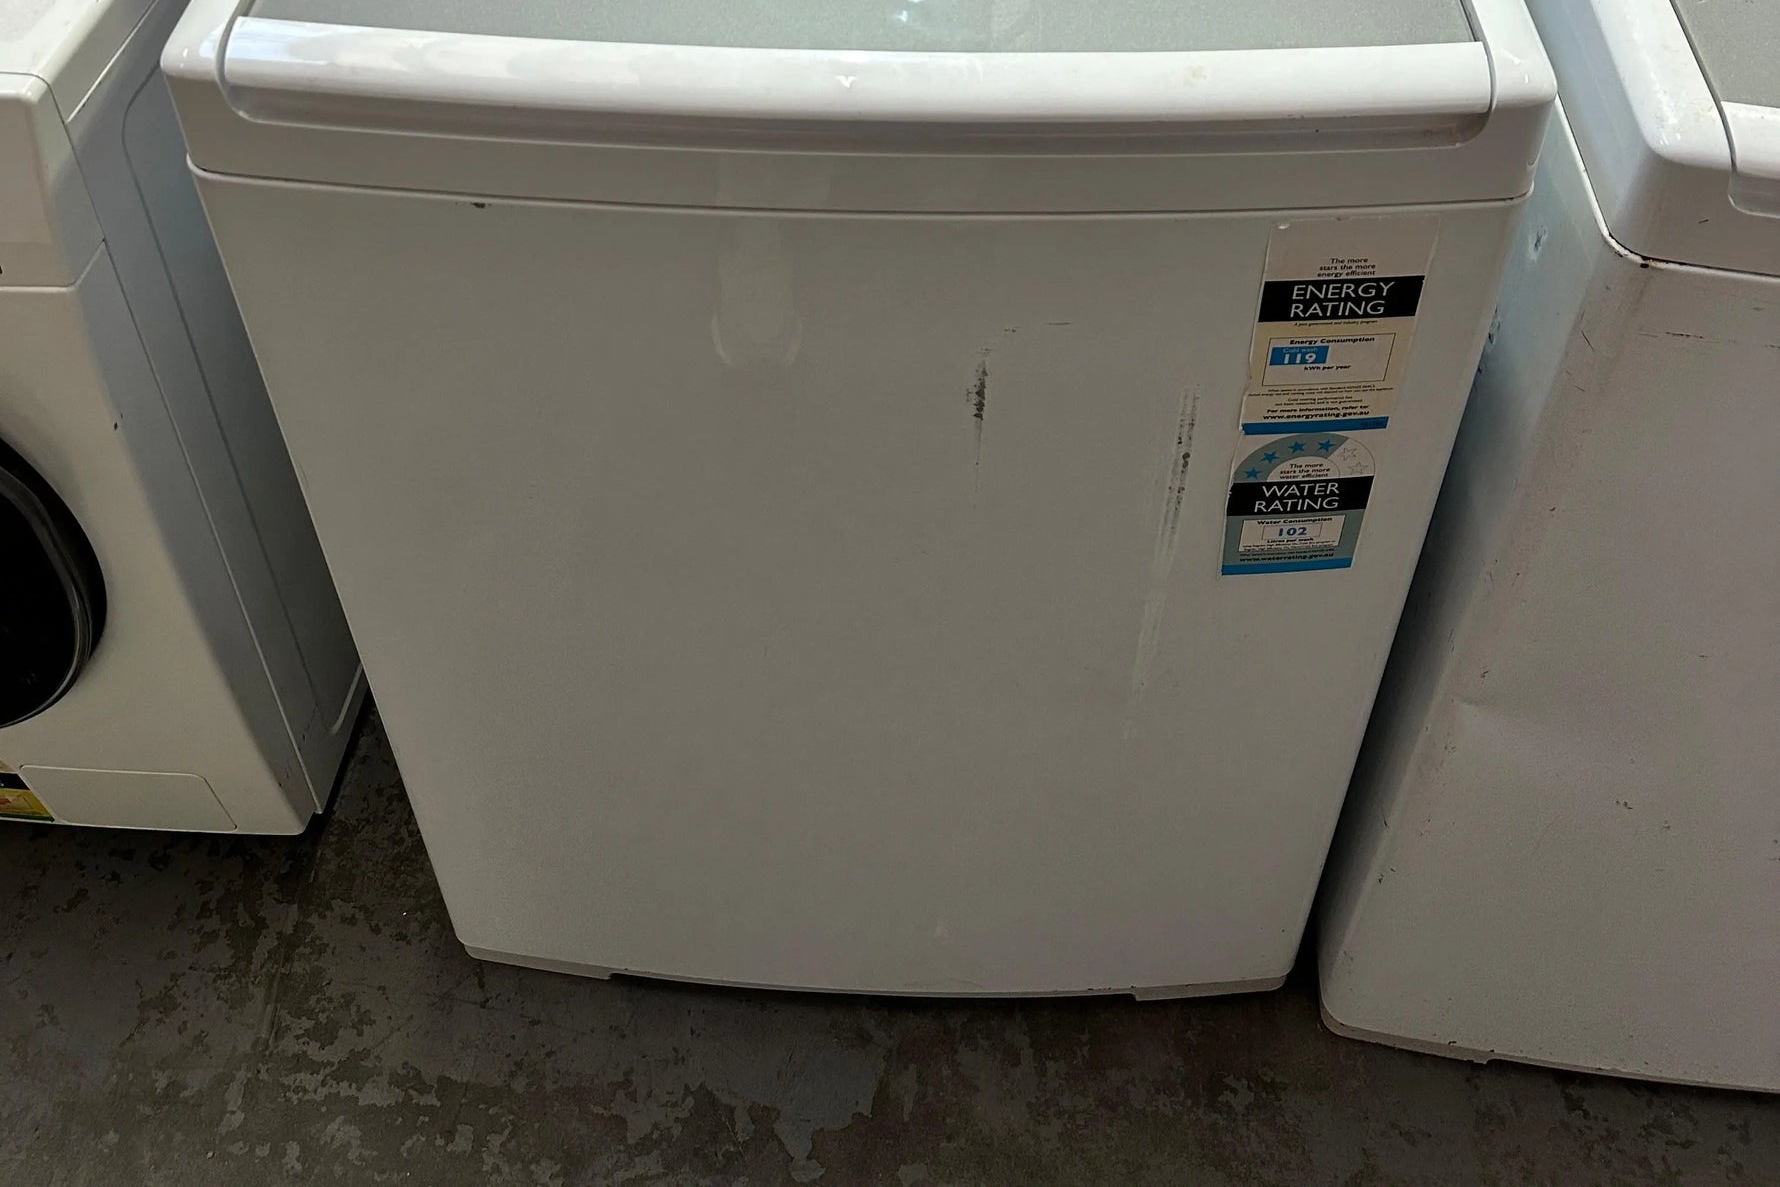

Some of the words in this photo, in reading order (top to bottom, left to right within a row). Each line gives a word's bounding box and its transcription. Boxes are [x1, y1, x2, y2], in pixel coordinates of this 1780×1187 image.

[1292, 281, 1395, 300] ENERGY
[1290, 300, 1386, 318] RATING
[1284, 353, 1316, 364] 119
[1262, 410, 1370, 420] www.energyrating.gov.au
[1262, 482, 1340, 497] WATER
[1254, 497, 1339, 513] RATING
[1278, 527, 1307, 537] 102
[1240, 553, 1334, 562] www.waterrating.gov.au
